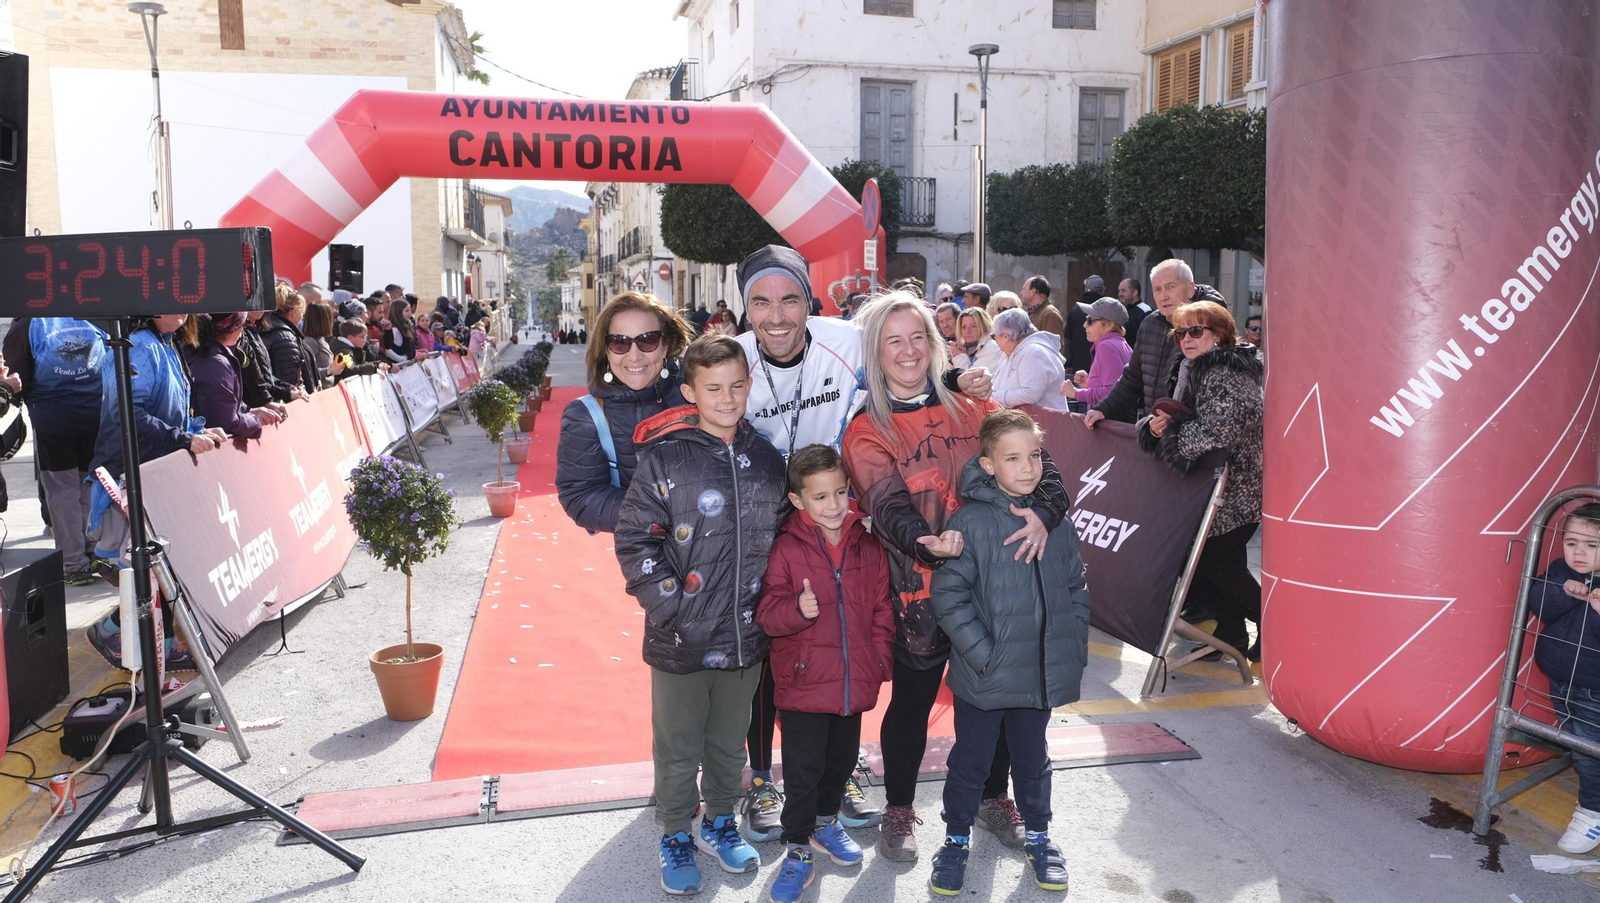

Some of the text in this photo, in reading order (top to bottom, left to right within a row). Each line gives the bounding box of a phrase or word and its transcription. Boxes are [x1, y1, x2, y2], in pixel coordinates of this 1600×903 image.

[440, 97, 690, 125] AYUNTAMIENTO
[448, 129, 683, 172] CANTORIA
[1369, 149, 1600, 438] www.teamergy.
[781, 389, 841, 414] DESMPARADOS
[208, 527, 279, 608] TEAMERGY
